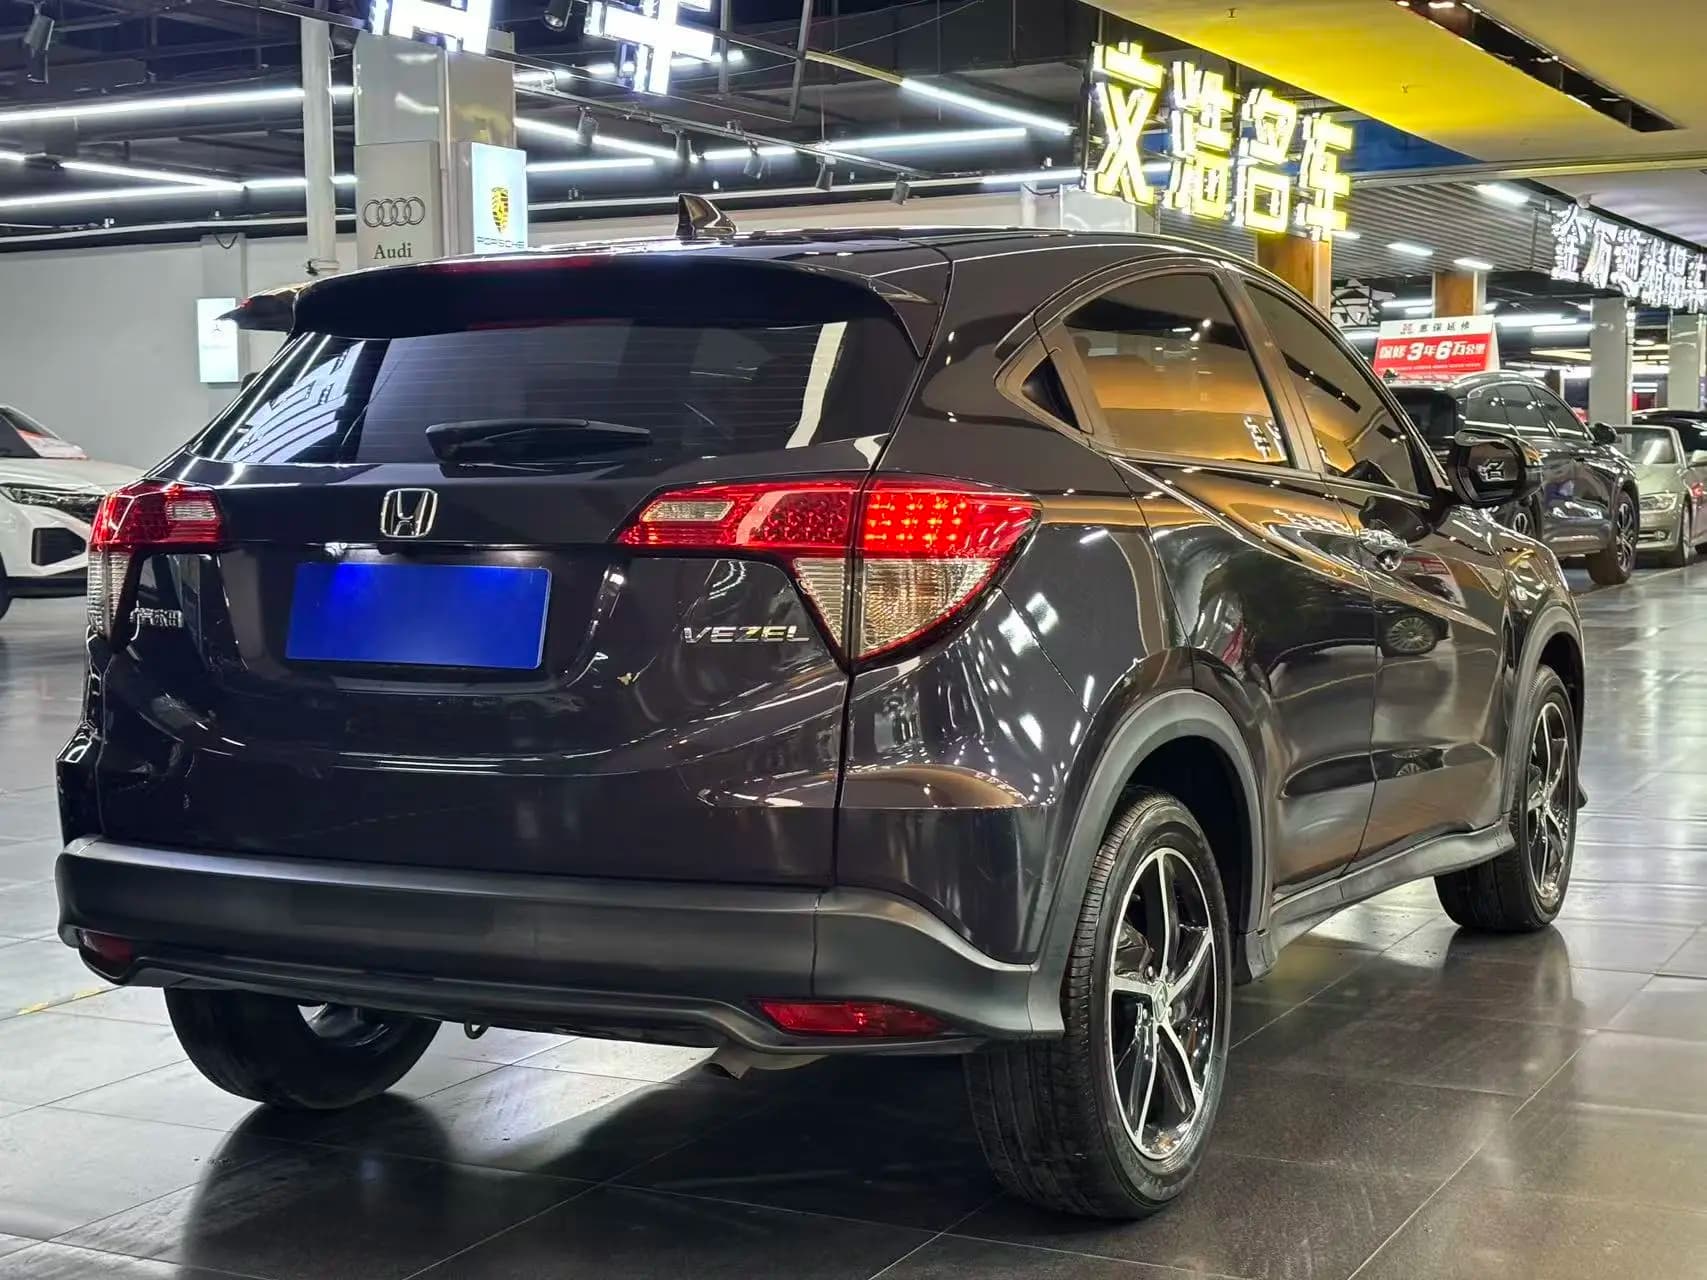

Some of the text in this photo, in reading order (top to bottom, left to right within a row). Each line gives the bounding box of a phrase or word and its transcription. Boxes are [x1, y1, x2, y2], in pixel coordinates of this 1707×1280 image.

[1091, 40, 1353, 242] 文浩名车
[373, 242, 413, 259] Audi
[476, 235, 525, 249] PORSCHE
[683, 625, 810, 643] VEZEL
